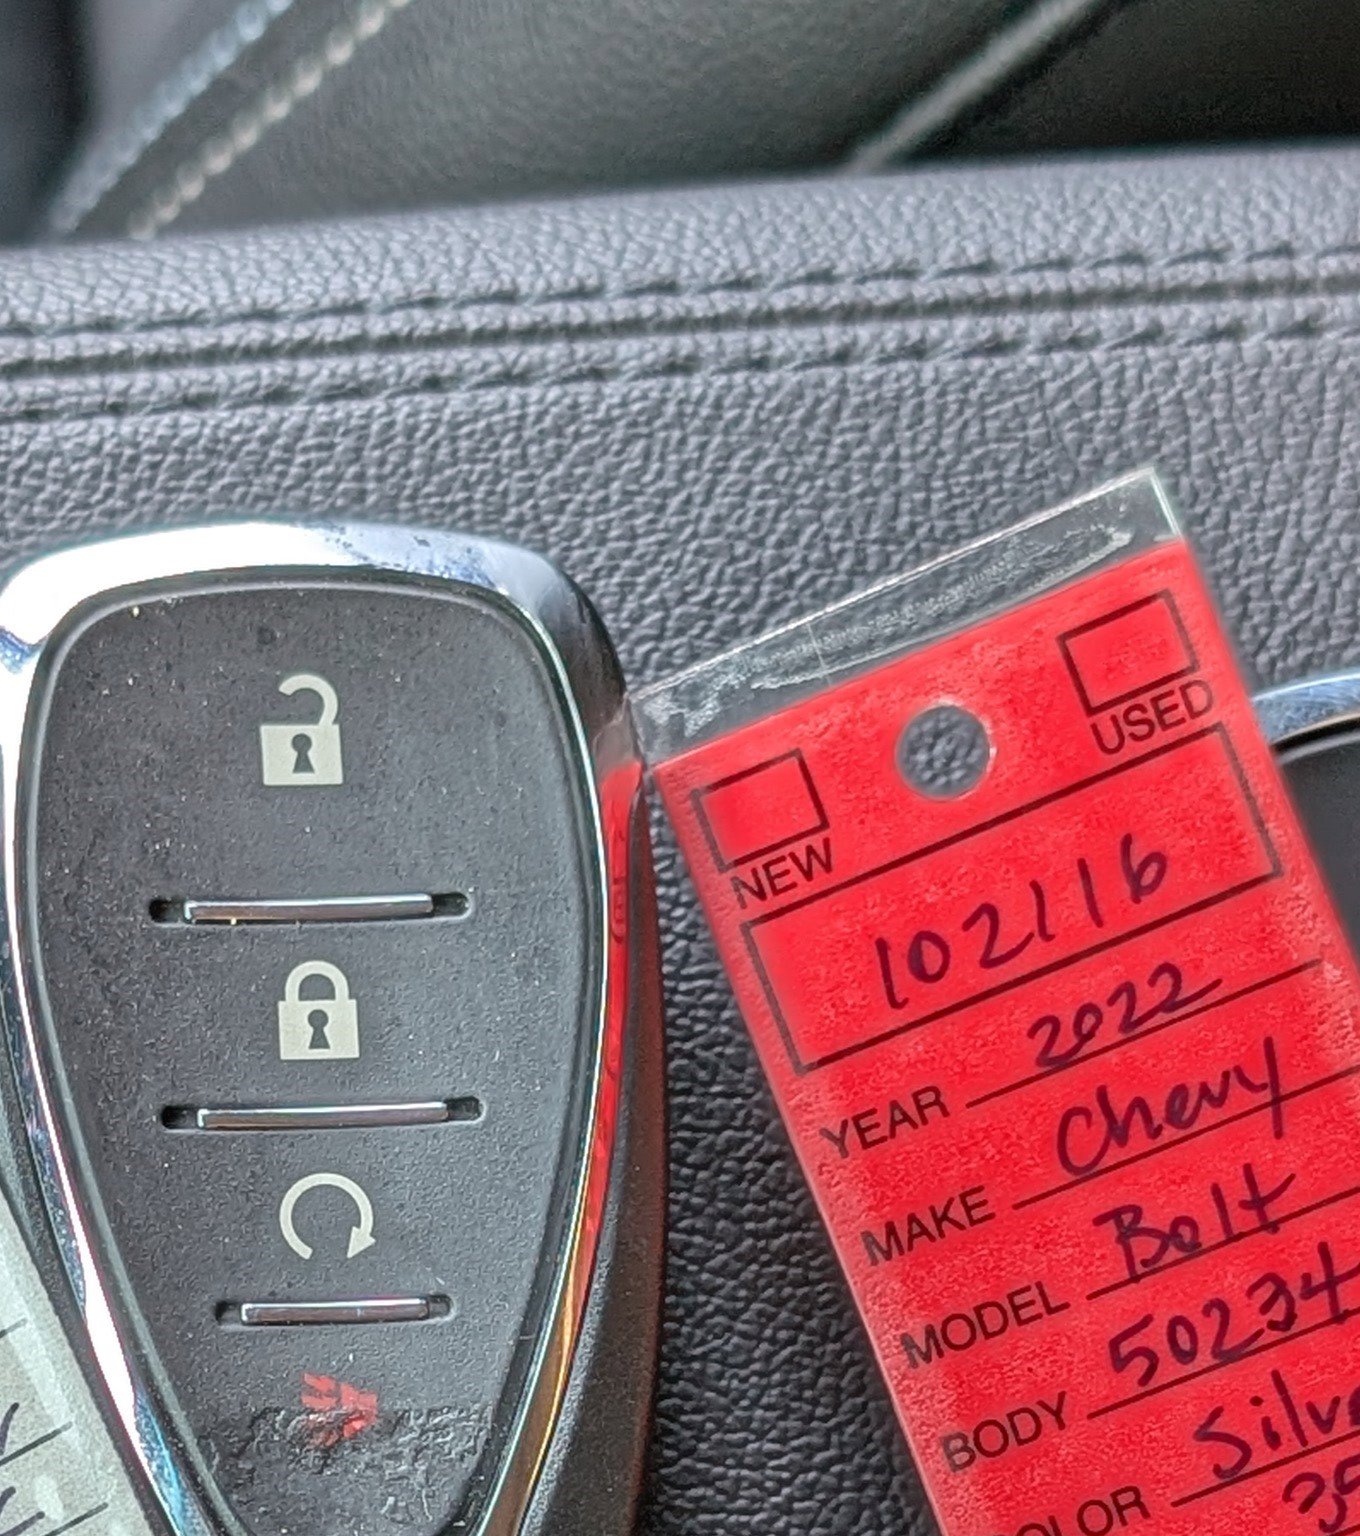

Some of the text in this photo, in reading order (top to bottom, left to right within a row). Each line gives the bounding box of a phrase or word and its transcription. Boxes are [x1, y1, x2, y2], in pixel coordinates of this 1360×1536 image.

[1090, 677, 1215, 757] USED
[730, 837, 834, 909] NEW
[874, 833, 1168, 1009] 102116
[1025, 962, 1223, 1068] 2022
[820, 1086, 950, 1160] YEAR
[1056, 1036, 1283, 1177] Chevy
[861, 1185, 995, 1267] MAKE
[1092, 1163, 1296, 1277] Bolt
[898, 1280, 1070, 1369] MODEL
[942, 1391, 1068, 1473] BODY
